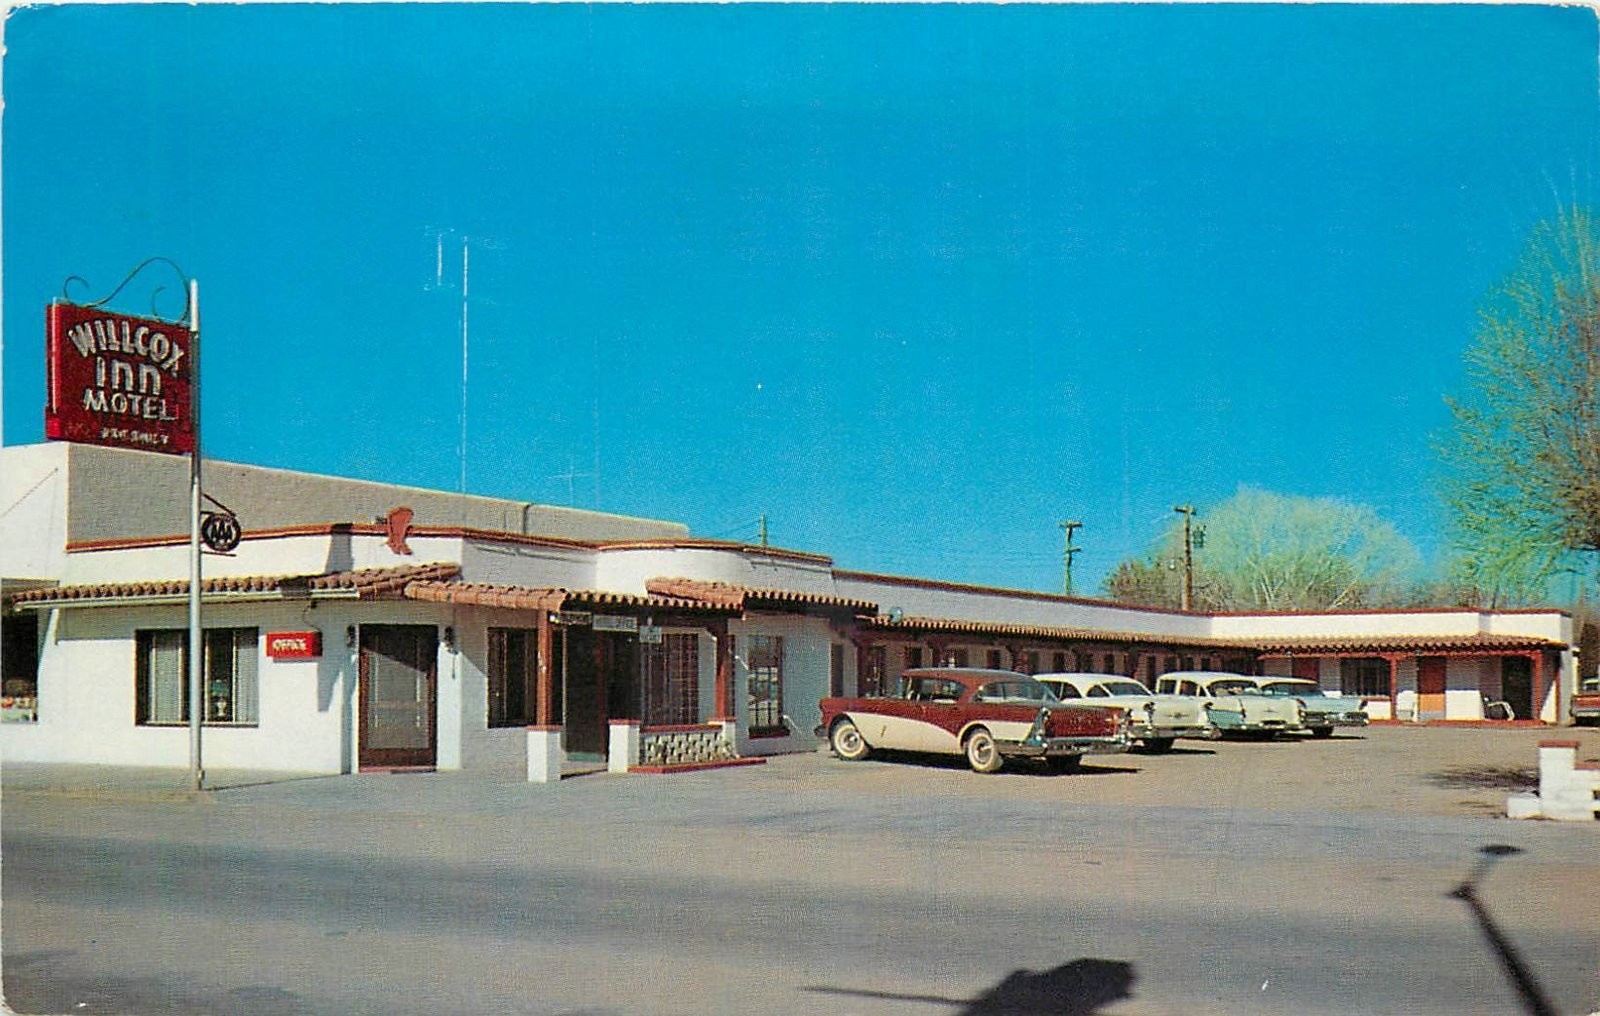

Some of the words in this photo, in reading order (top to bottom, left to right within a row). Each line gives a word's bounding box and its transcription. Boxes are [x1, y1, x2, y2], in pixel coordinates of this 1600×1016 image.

[68, 319, 184, 377] WILLCOX
[83, 388, 176, 420] MOTEL
[207, 520, 236, 544] AAA
